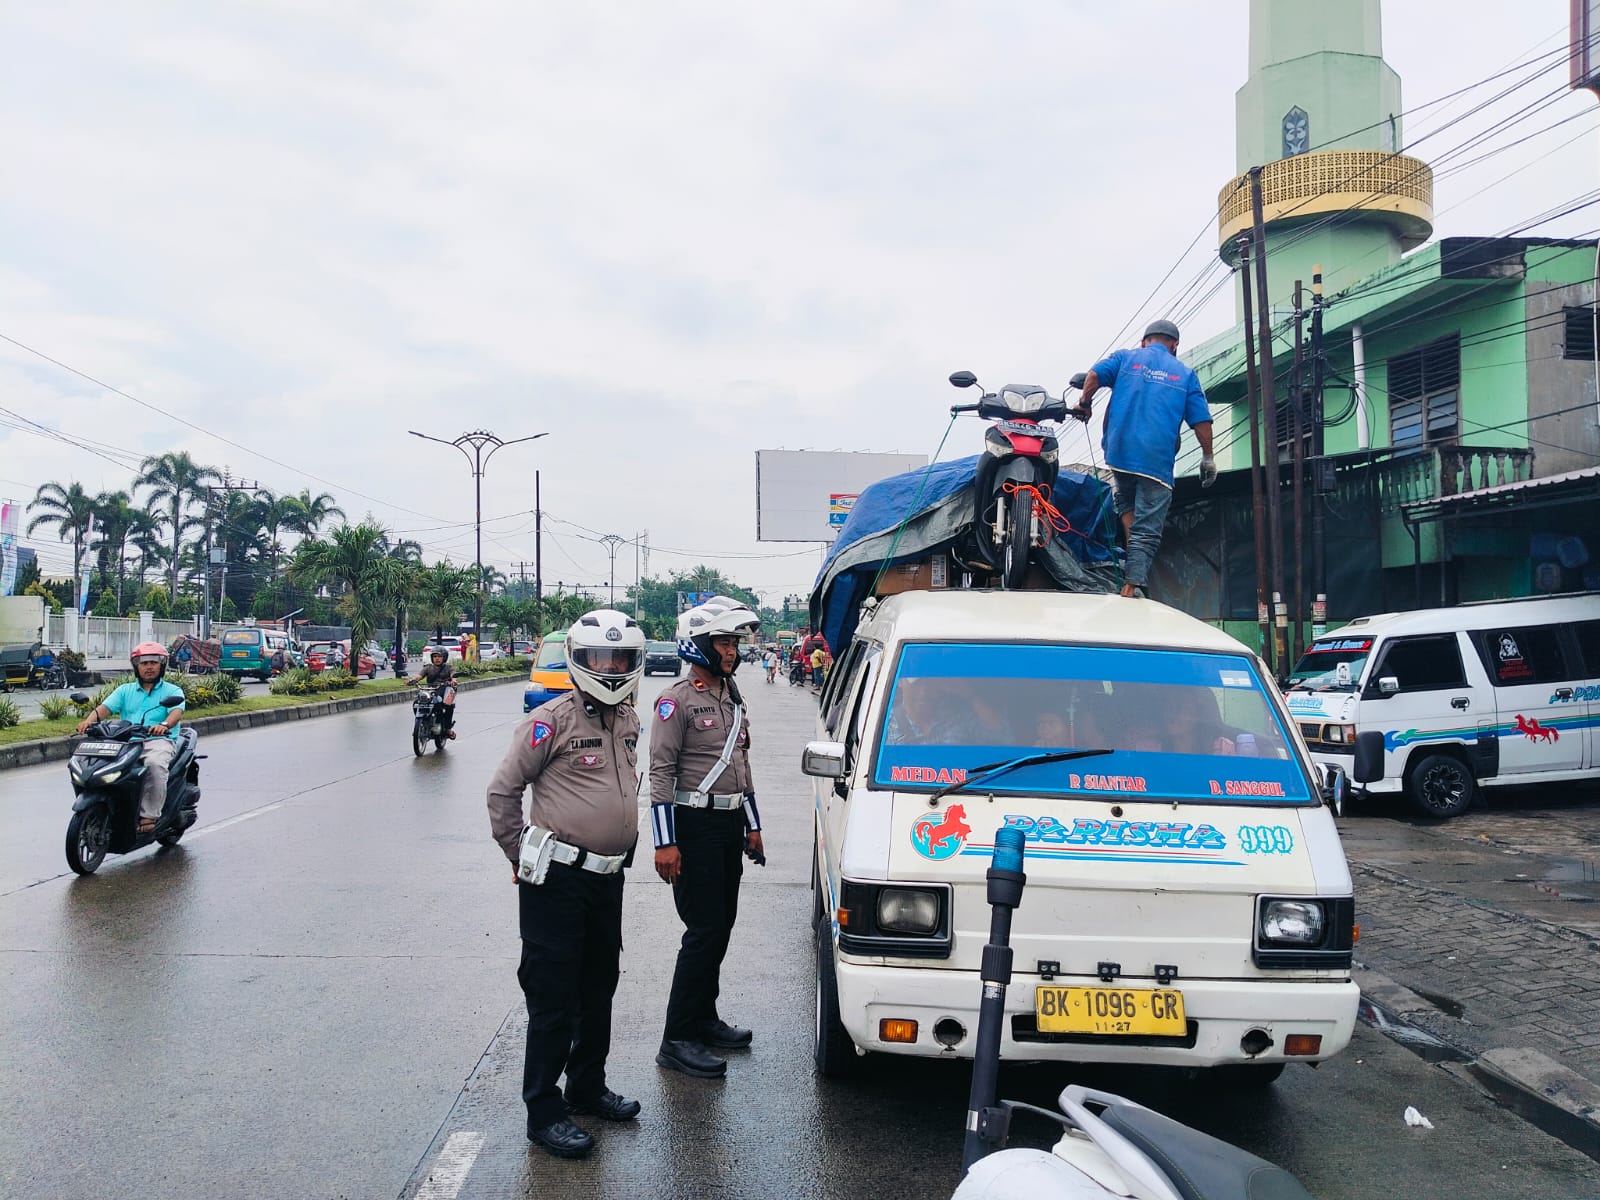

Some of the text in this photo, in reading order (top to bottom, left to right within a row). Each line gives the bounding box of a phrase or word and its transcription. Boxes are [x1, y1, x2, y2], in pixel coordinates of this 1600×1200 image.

[891, 766, 967, 784] MEDAN
[1084, 774, 1147, 792] SIANTAR
[1209, 780, 1286, 798] D. SANGGUL
[1238, 825, 1293, 855] 999
[1042, 990, 1179, 1020] BK 1096 GR
